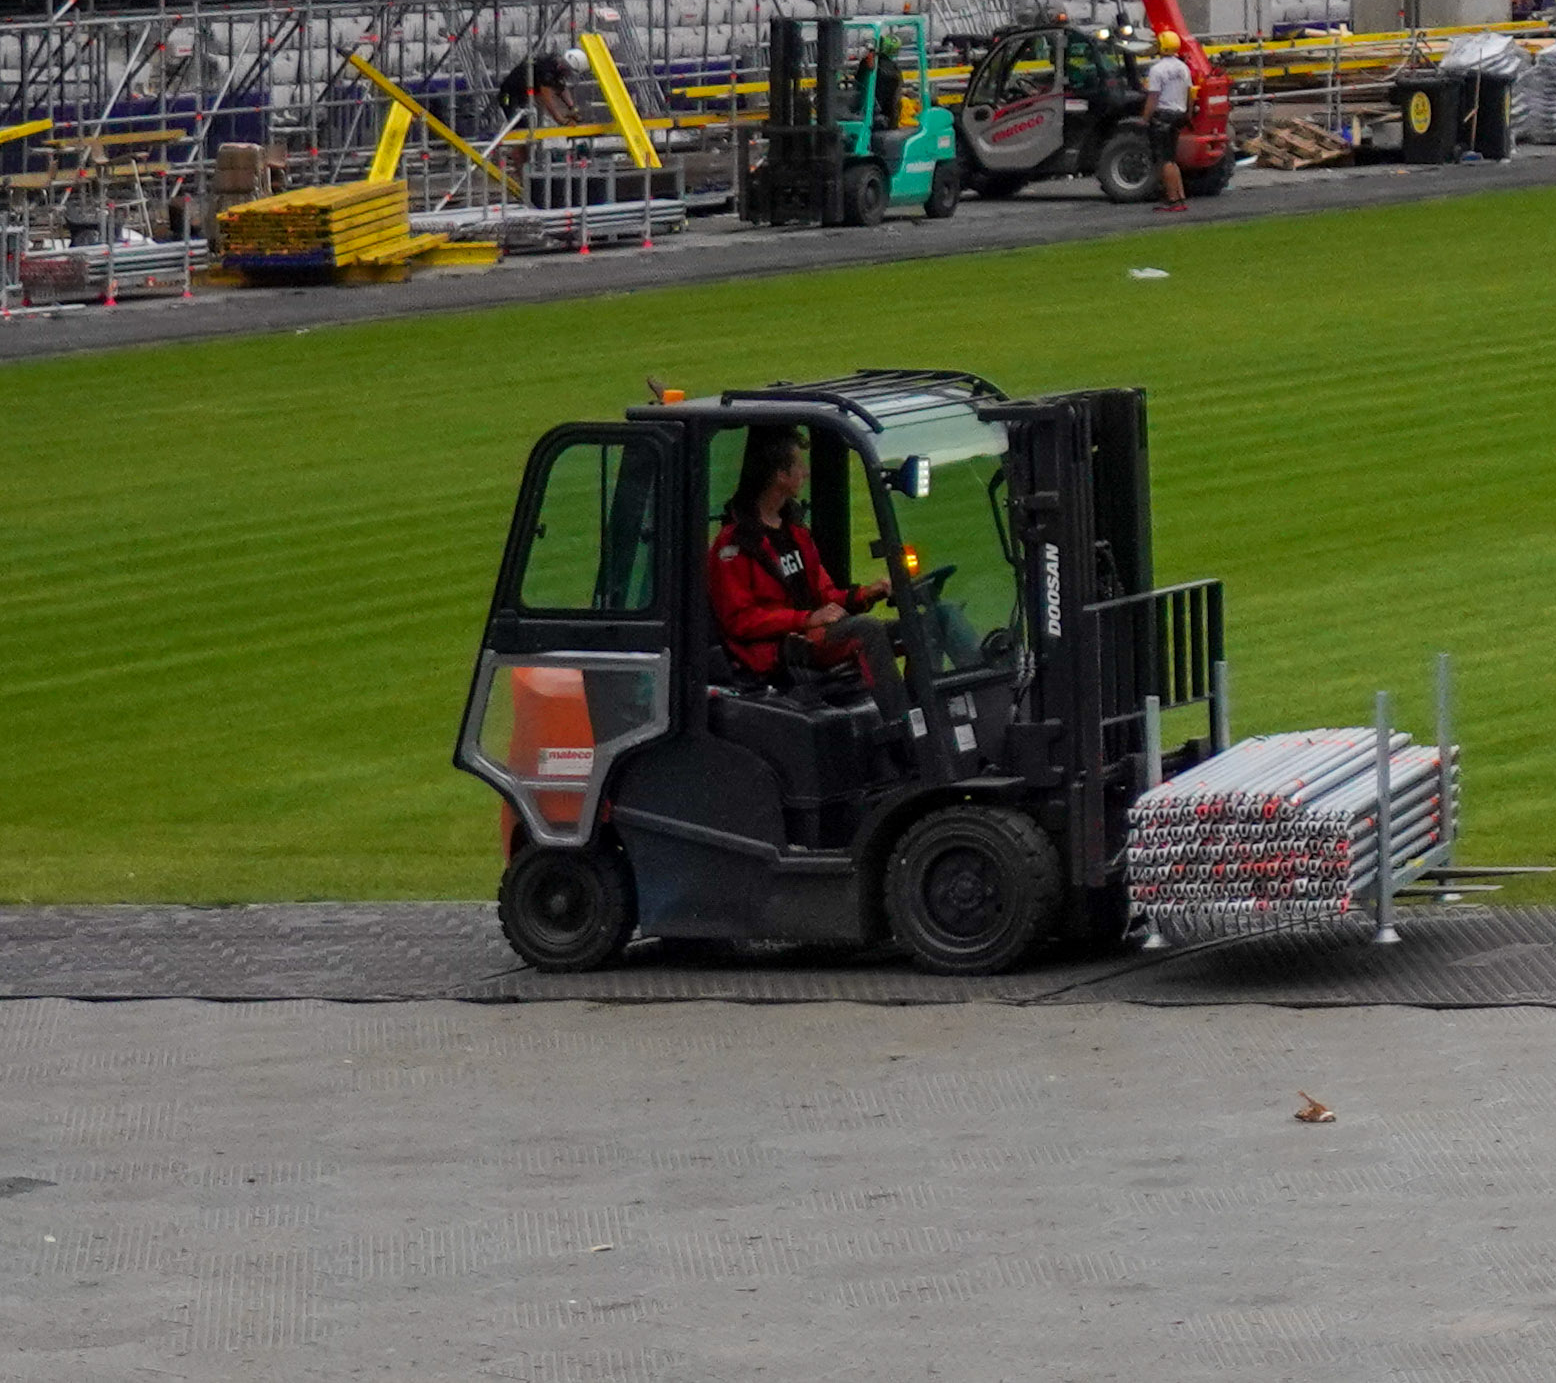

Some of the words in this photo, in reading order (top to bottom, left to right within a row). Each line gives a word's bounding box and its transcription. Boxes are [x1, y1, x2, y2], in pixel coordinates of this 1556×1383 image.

[992, 114, 1045, 143] mateco
[1045, 542, 1062, 638] DOOSAN
[548, 750, 592, 759] mateco
